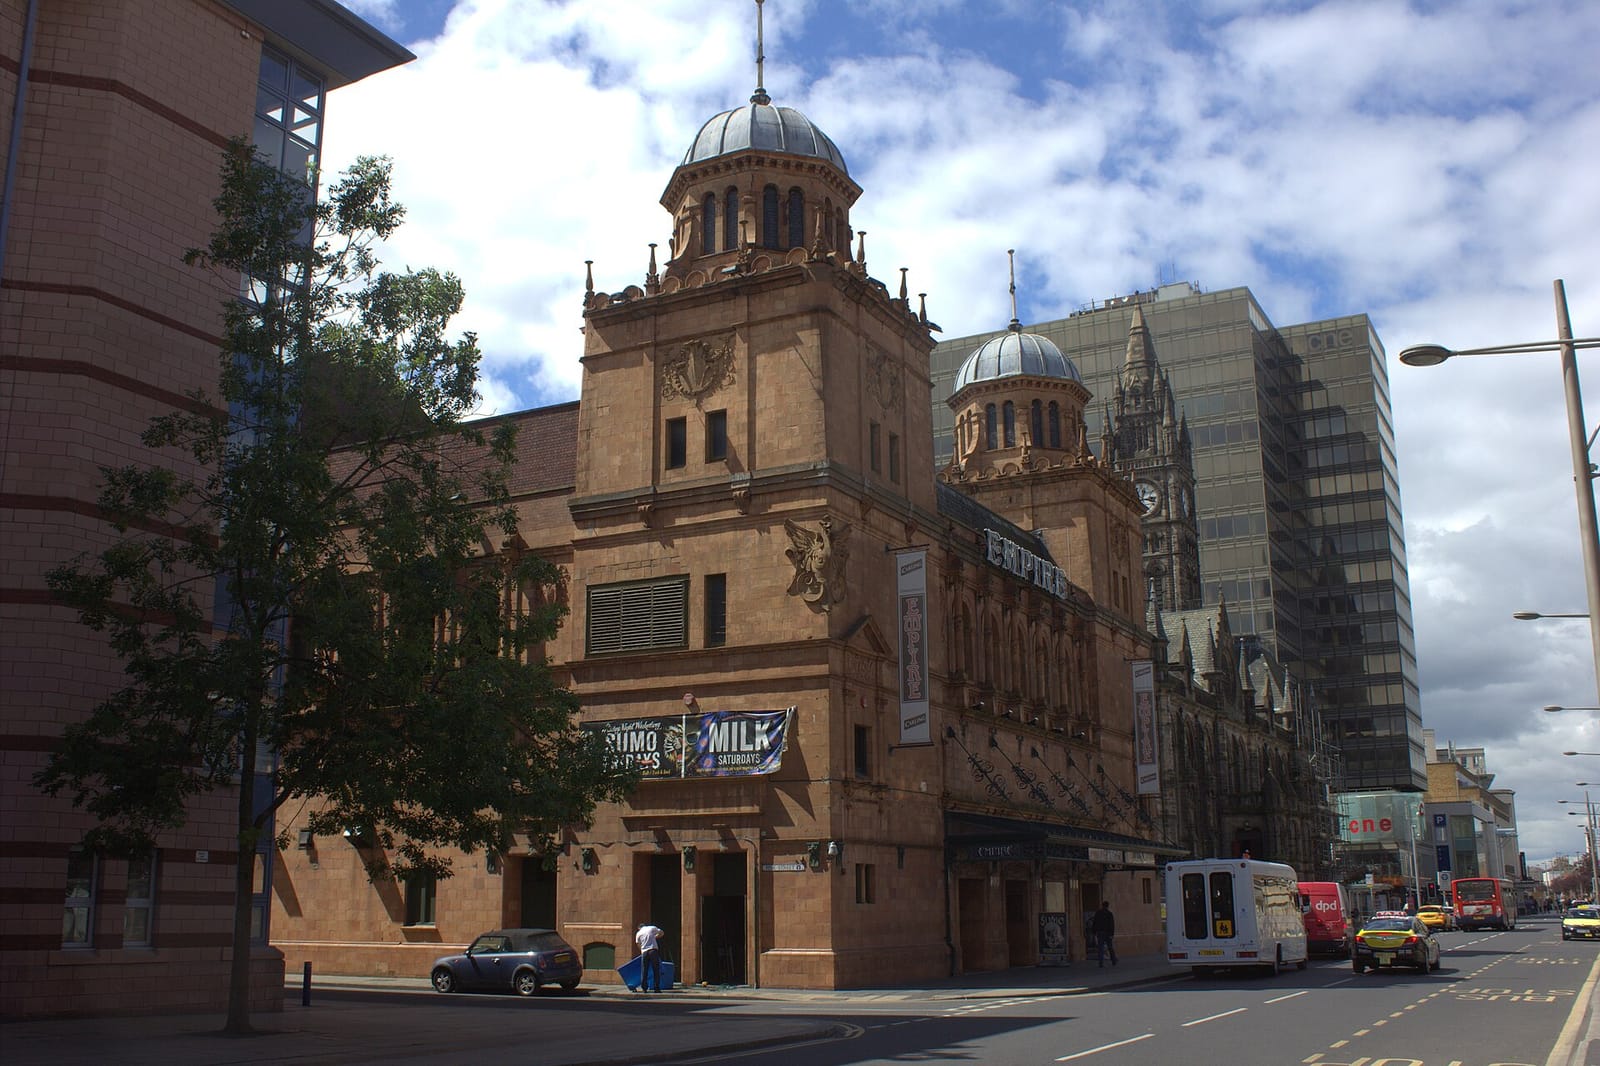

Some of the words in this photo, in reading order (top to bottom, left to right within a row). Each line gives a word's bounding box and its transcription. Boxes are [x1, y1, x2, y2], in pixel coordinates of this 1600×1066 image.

[983, 528, 1068, 600] EMPIRE
[904, 598, 922, 699] EMPIRE
[605, 731, 657, 752] SUMO
[709, 720, 772, 752] MILK
[718, 753, 761, 765] SATURDAYS
[1349, 818, 1392, 834] cne
[1436, 816, 1444, 824] P
[1315, 900, 1338, 913] dpd
